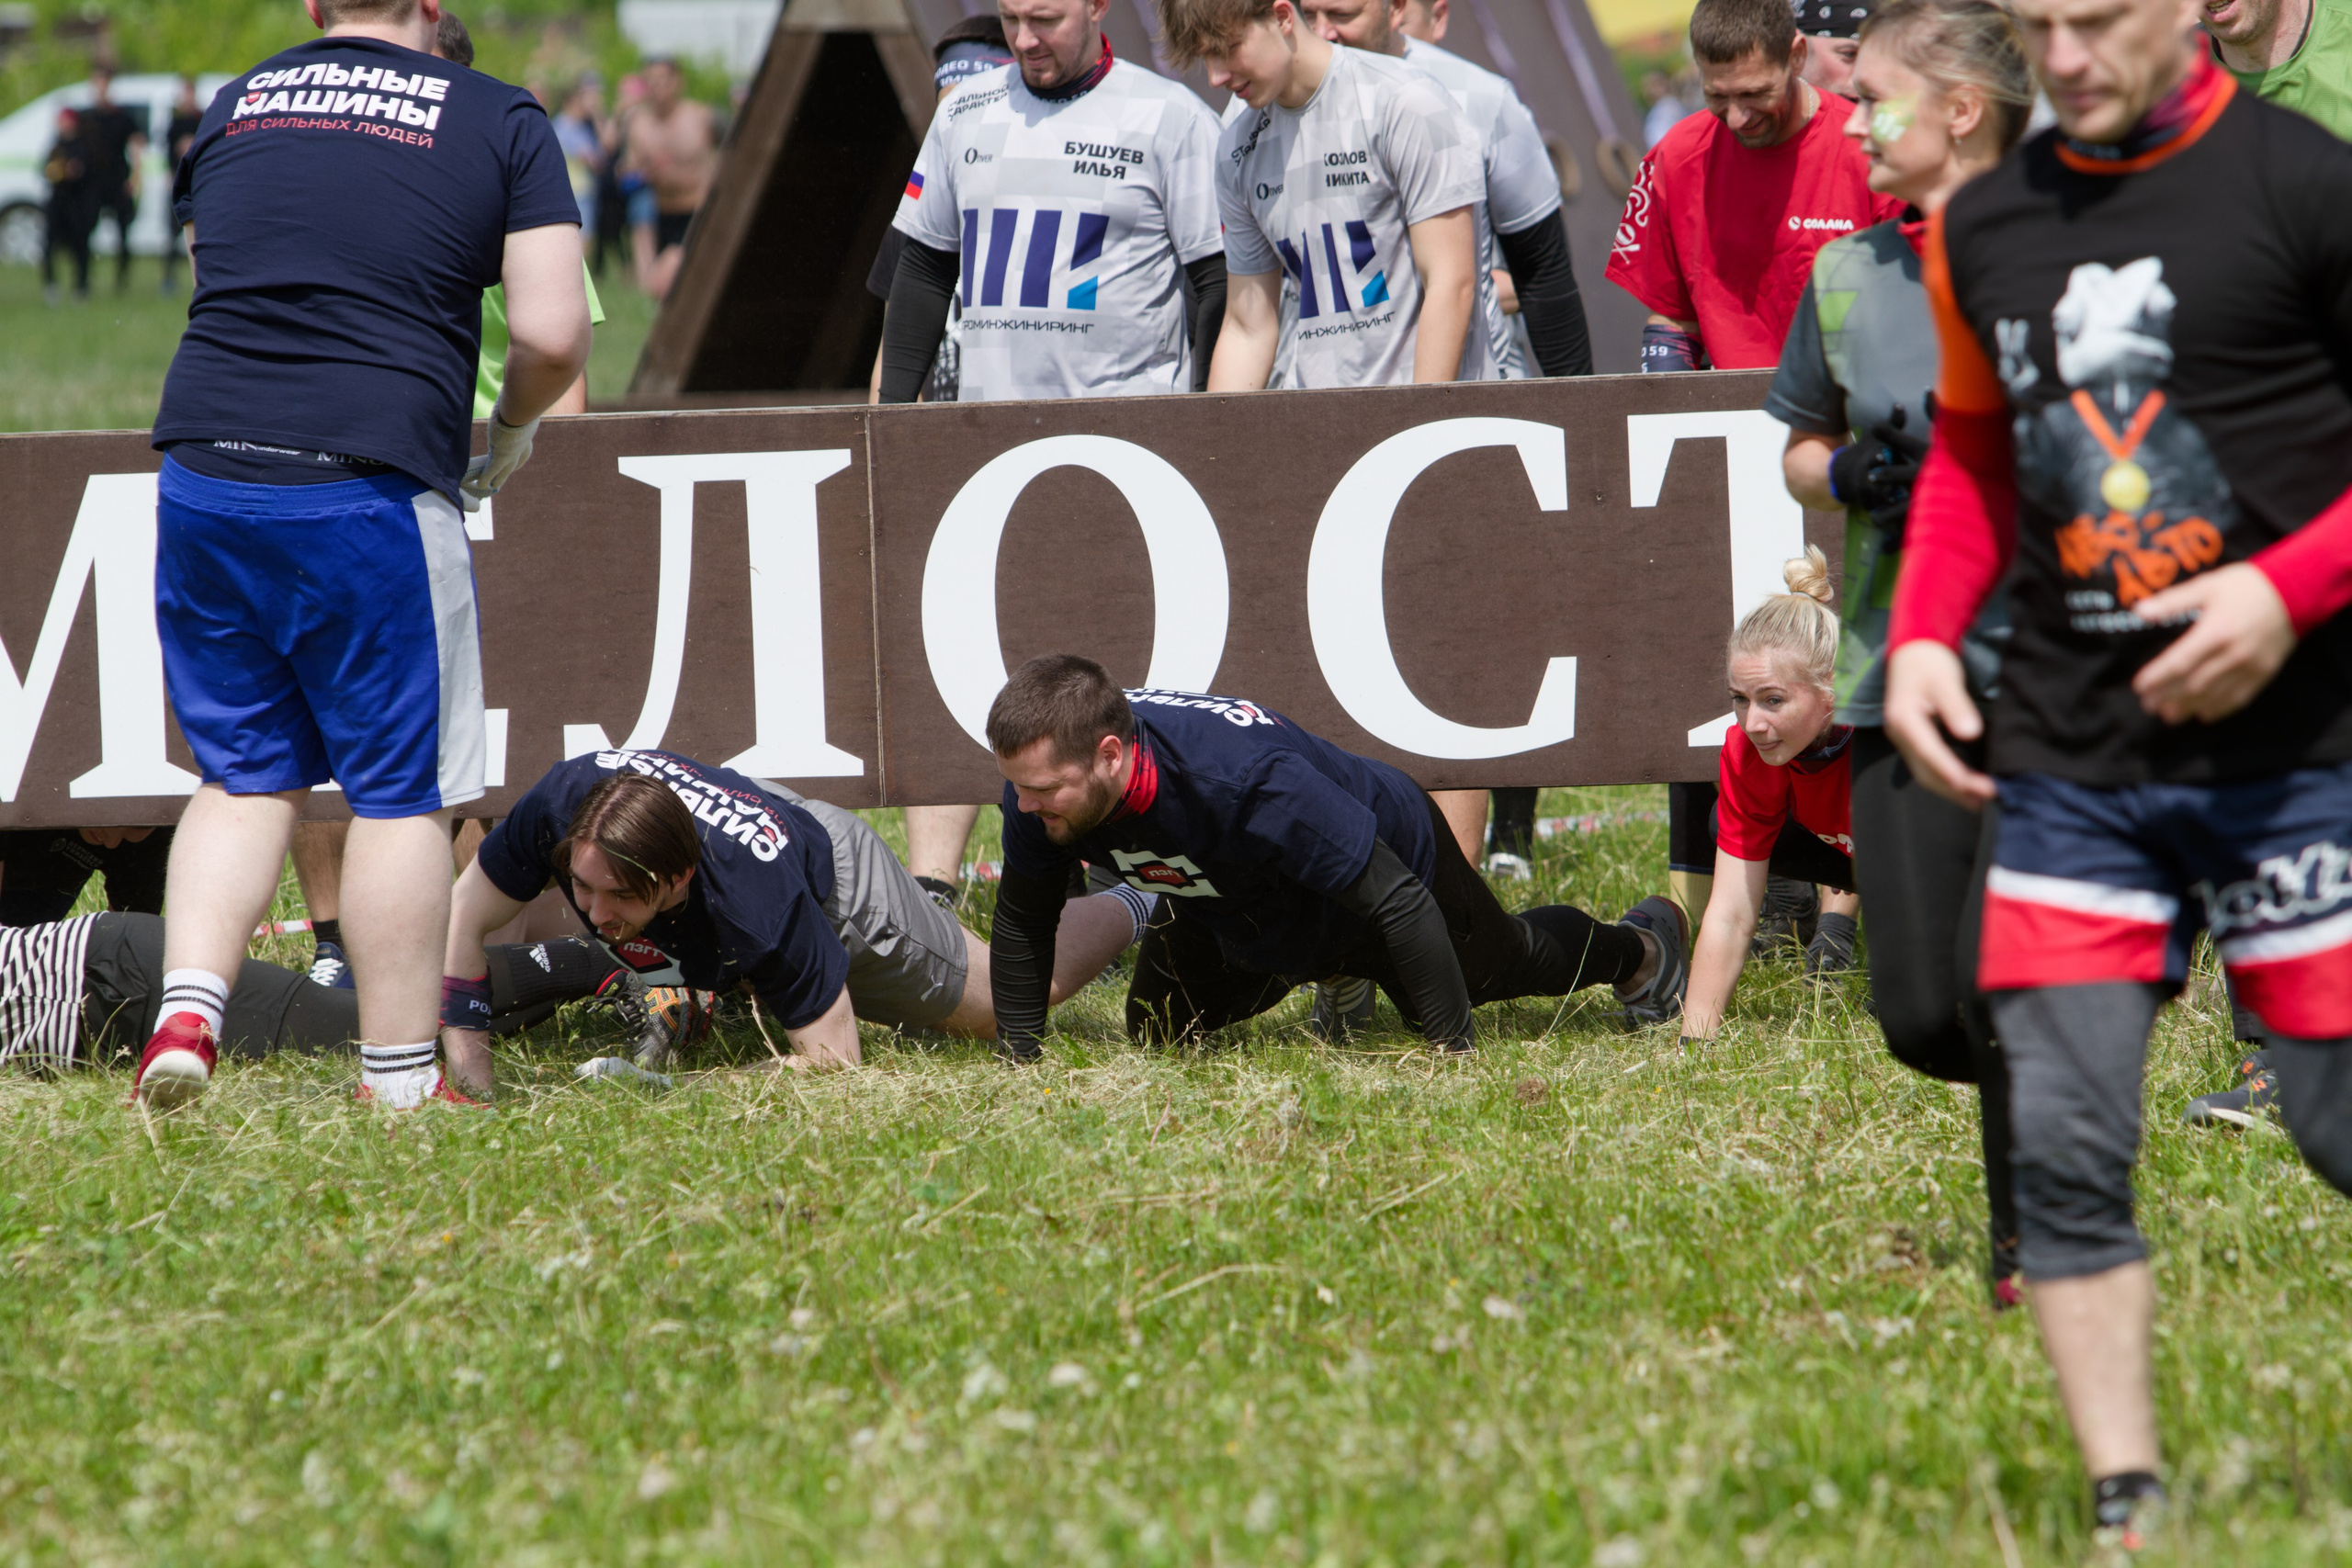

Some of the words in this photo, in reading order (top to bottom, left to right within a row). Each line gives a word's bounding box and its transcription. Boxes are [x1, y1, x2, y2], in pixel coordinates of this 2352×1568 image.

[246, 62, 451, 101] СИЛЬНЫЕ
[232, 90, 442, 130] МАШИНЫ
[225, 118, 258, 138] ДЛЯ
[260, 117, 351, 131] СИЛЬНЫХ
[354, 121, 435, 150] ЛЮДЕЙ
[1064, 141, 1145, 165] БУШУЕВ
[1073, 160, 1126, 180] ИЛЬЯ
[962, 319, 1095, 334] РОМИНЖИНИРИНГ
[537, 943, 551, 974] adidas
